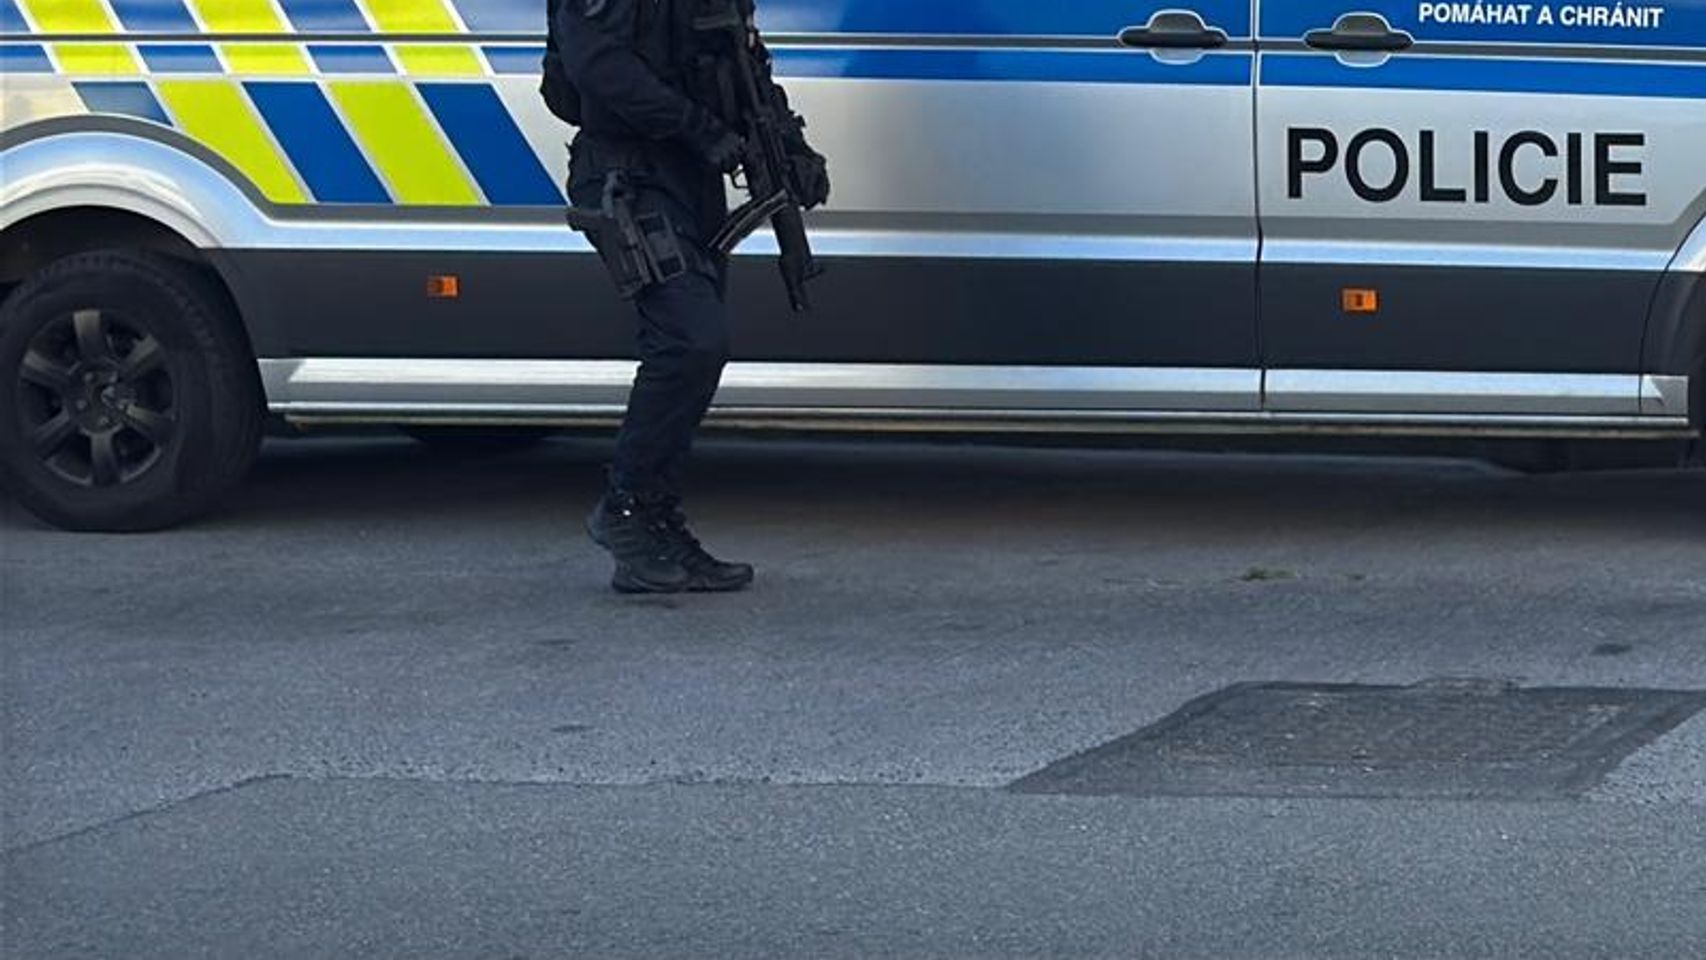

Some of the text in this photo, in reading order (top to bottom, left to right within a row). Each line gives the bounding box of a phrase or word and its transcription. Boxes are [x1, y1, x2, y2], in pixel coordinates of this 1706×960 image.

[1536, 4, 1554, 26] A
[1559, 2, 1665, 29] CHRÁNIT
[1287, 126, 1646, 207] POLICIE
